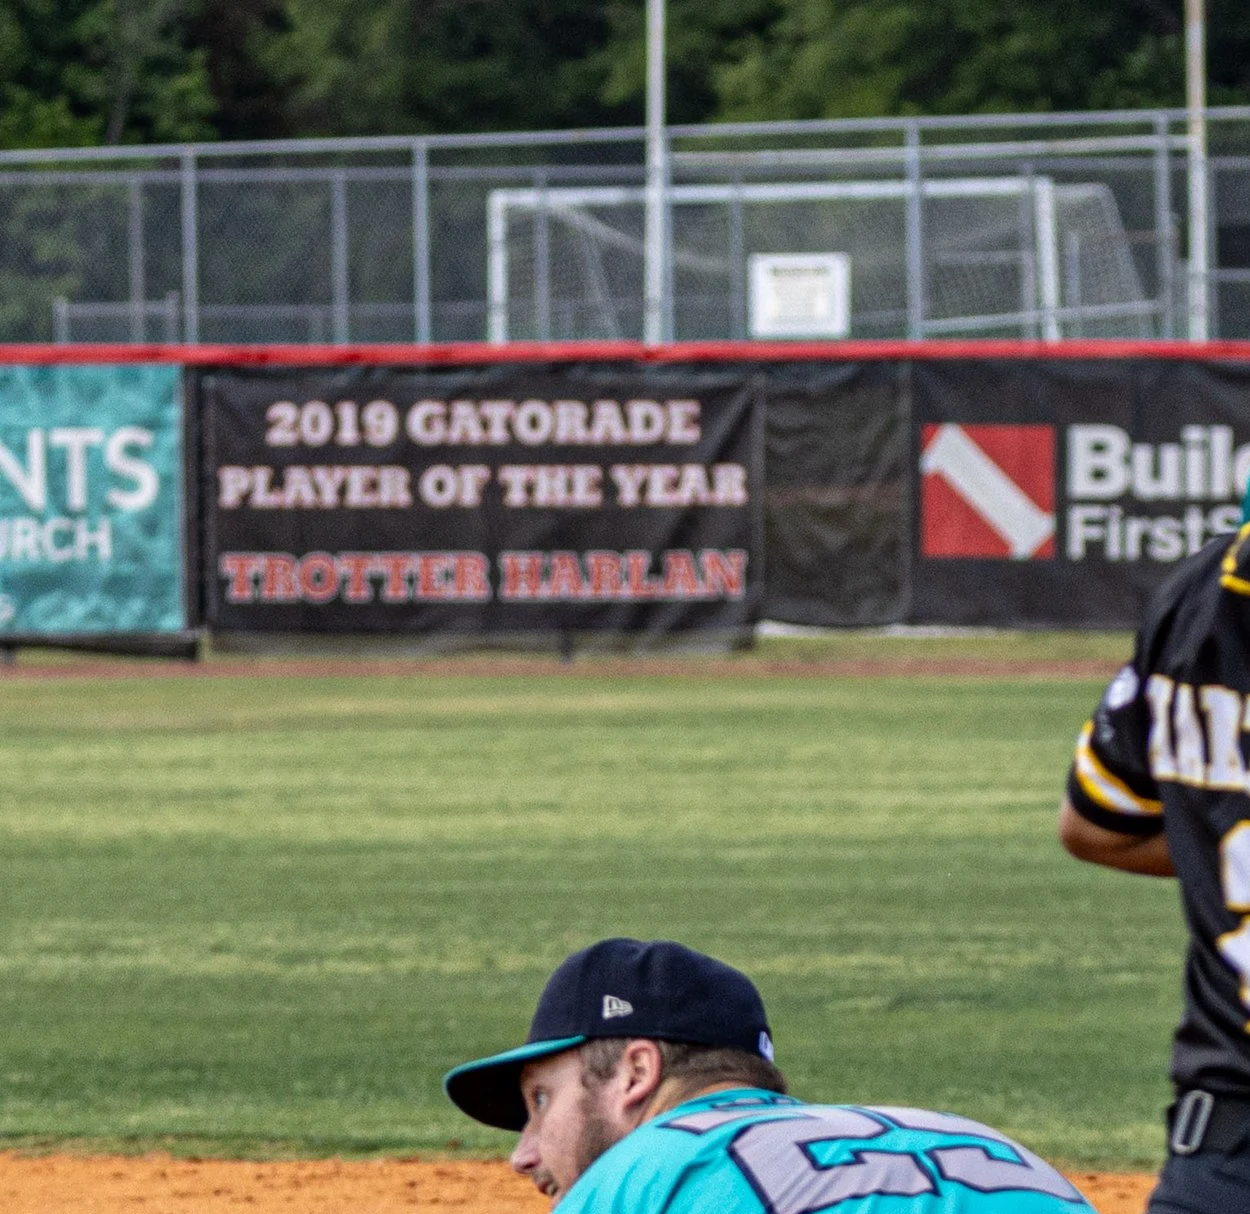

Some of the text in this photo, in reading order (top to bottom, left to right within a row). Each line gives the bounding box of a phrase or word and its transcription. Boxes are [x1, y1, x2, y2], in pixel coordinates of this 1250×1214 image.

[264, 399, 701, 447] 2019 GATORADE
[0, 425, 160, 513] NTS
[217, 462, 748, 509] PLAYER OF THE YEAR
[218, 549, 750, 604] TROTTER HARLAN
